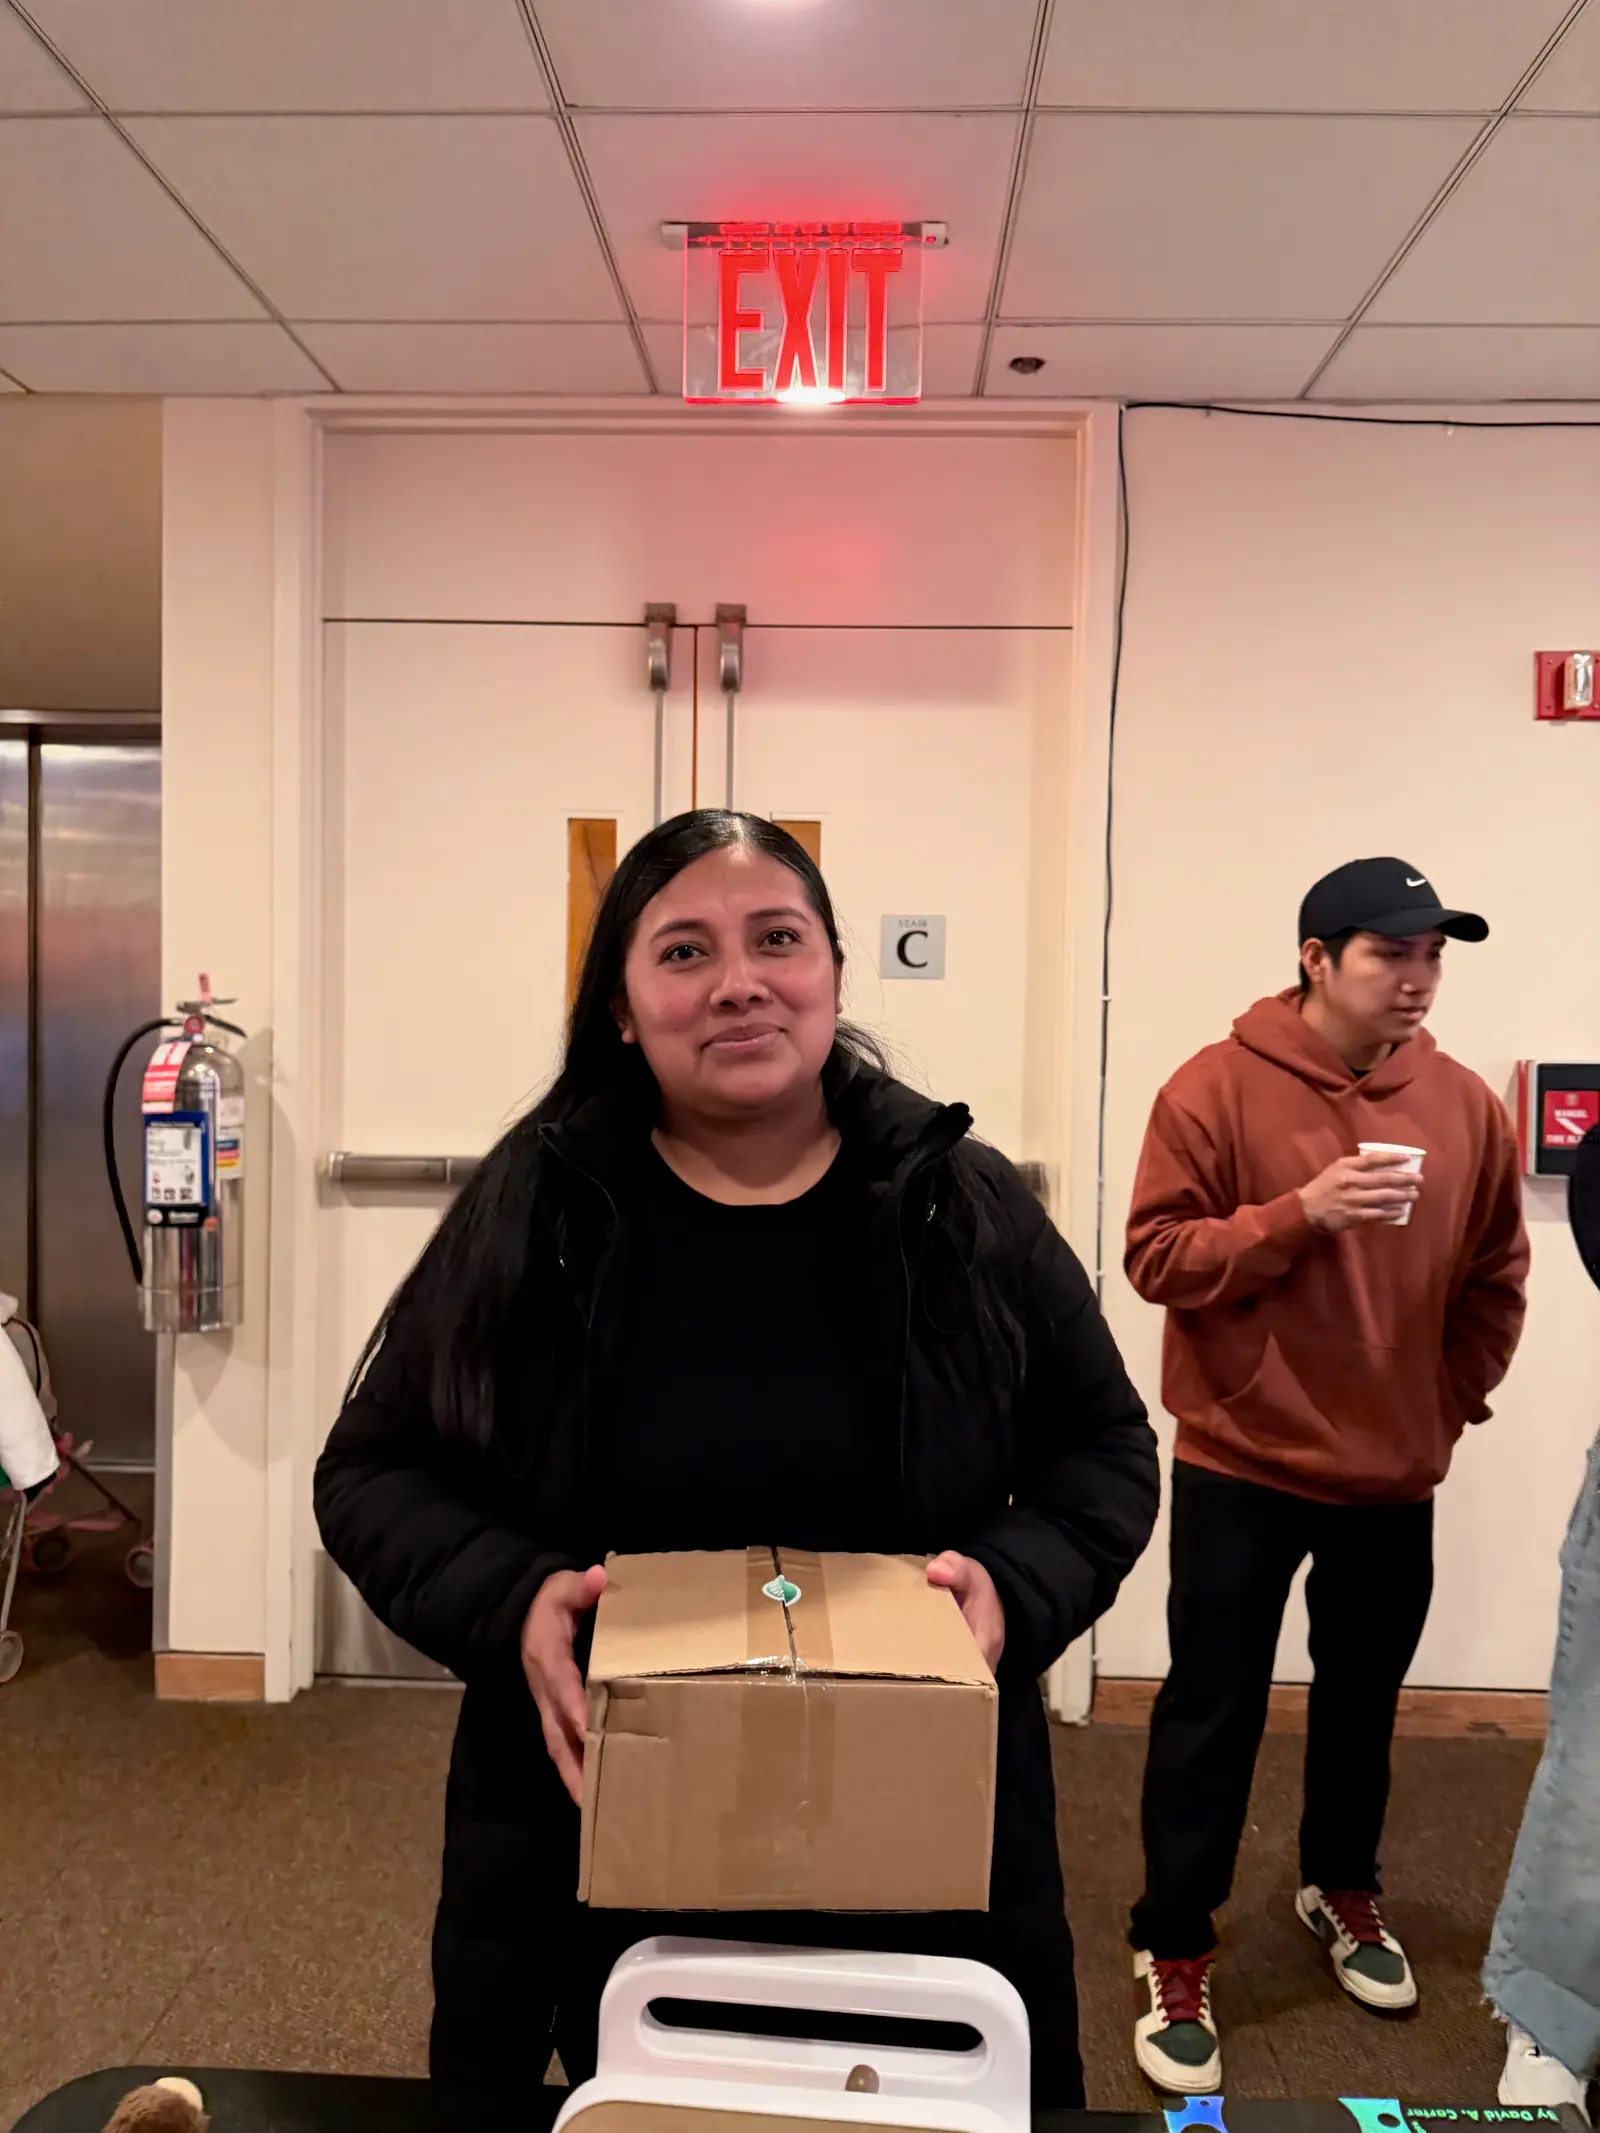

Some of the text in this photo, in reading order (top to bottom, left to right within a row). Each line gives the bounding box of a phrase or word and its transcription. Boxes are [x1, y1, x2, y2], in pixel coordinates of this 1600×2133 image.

[719, 249, 903, 391] EXIT
[898, 919, 927, 929] STAIR
[896, 930, 928, 968] C
[1407, 2108, 1457, 2120] Carter
[1483, 2109, 1534, 2121] David
